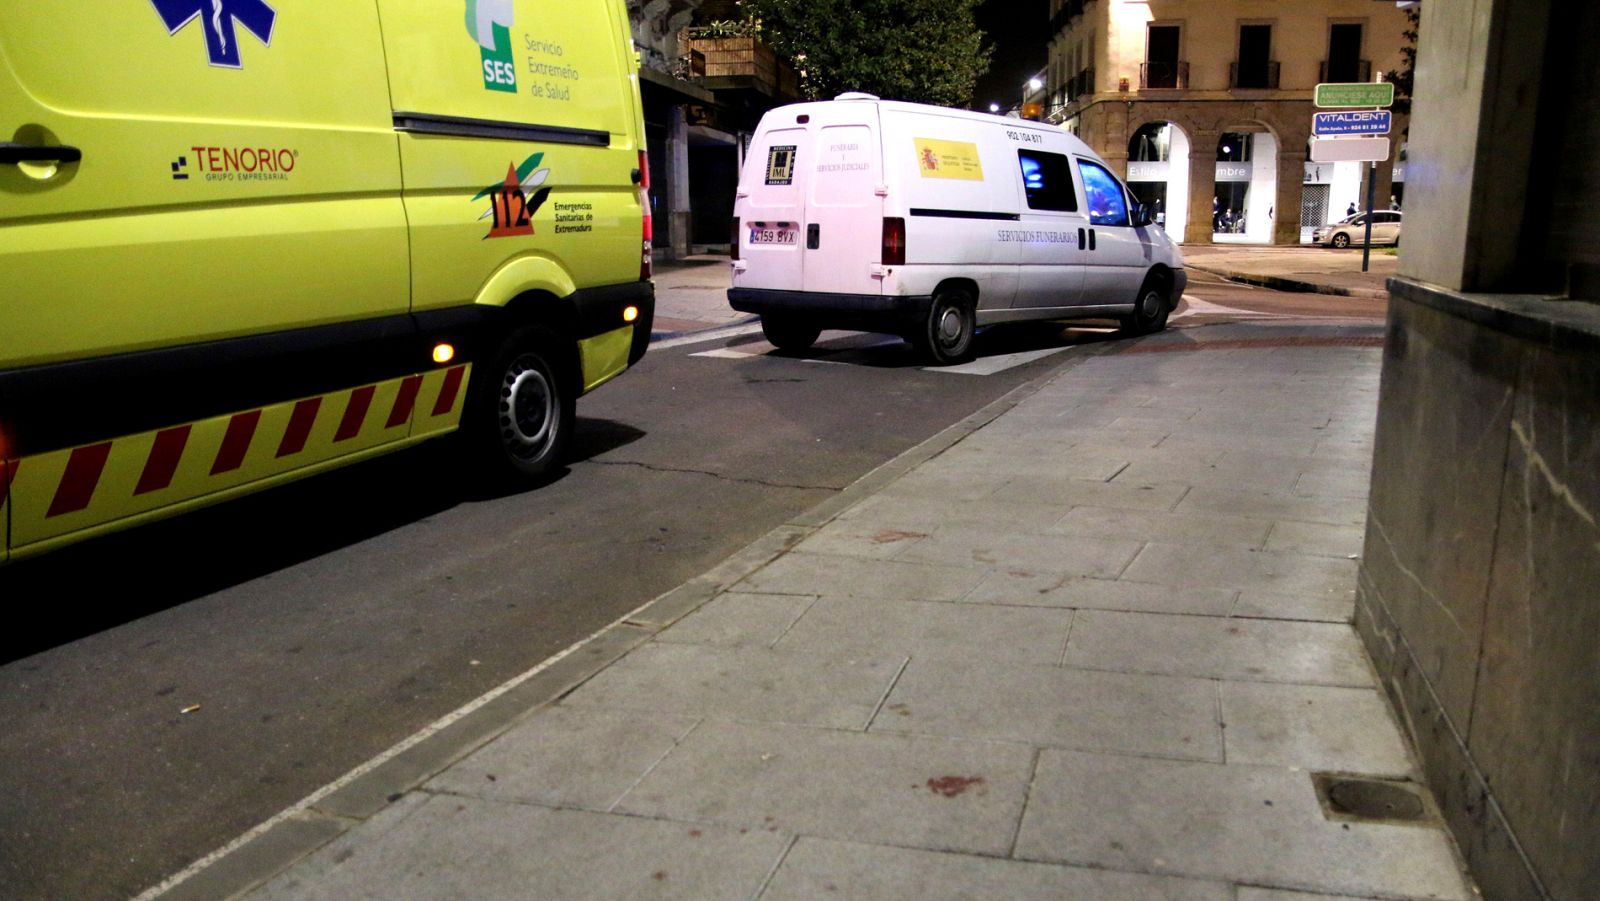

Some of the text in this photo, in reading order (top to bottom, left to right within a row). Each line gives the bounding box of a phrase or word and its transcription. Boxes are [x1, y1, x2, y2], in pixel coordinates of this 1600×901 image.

[524, 33, 563, 57] Servicio
[483, 58, 515, 86] SES
[527, 56, 579, 81] Extremeño
[531, 82, 570, 101] de Salud
[1319, 113, 1386, 122] VITALDENT
[1007, 130, 1042, 144] 902 104 877
[205, 173, 289, 181] GRUPO EMPRESARIAL
[772, 168, 786, 178] IML
[1217, 167, 1246, 176] mbre
[490, 188, 529, 229] 112
[554, 202, 592, 212] Emergencias
[555, 213, 593, 222] Sanitarias de
[555, 224, 592, 234] Extremadura
[777, 230, 794, 243] BVX
[997, 230, 1078, 244] SERVICIOS FUNERARIOS
